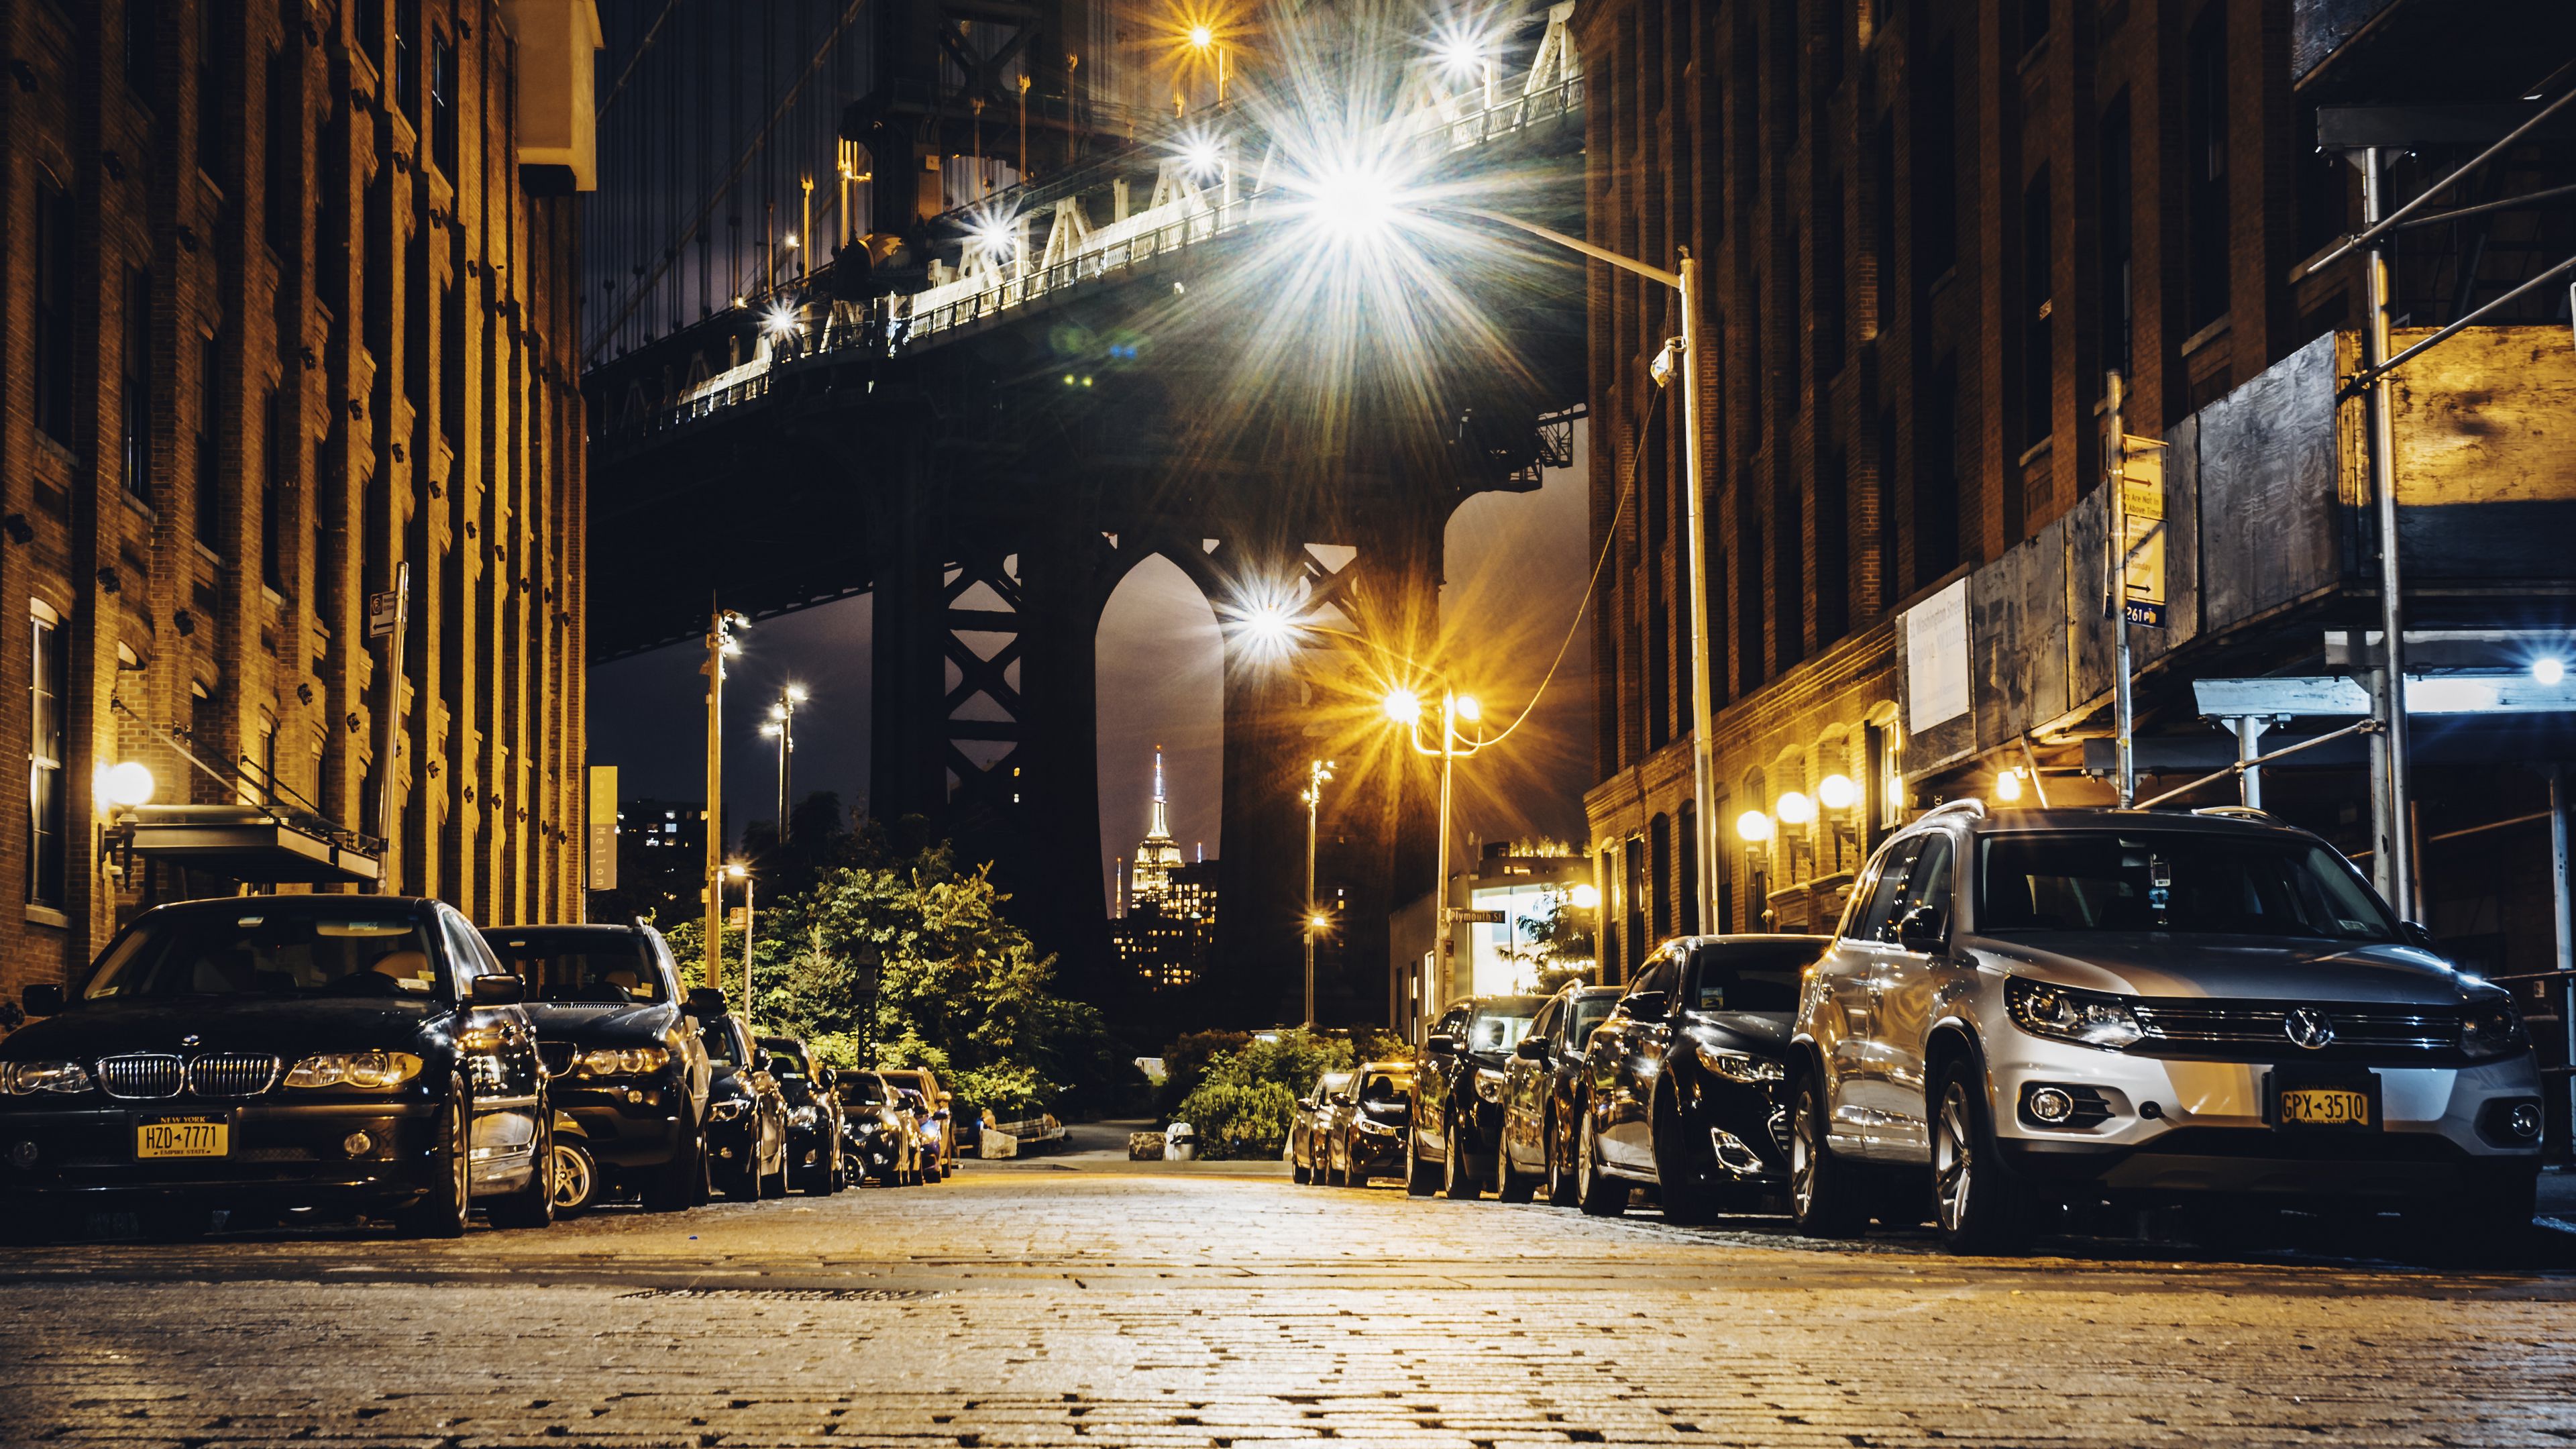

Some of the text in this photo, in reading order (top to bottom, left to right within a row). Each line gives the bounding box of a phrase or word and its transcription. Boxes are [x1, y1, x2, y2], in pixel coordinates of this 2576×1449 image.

[2132, 494, 2141, 502] Are
[2143, 496, 2152, 504] Not
[2129, 504, 2145, 515] Above
[2131, 559, 2151, 573] Sunday
[1947, 595, 1963, 619] Street
[596, 771, 606, 820] Smack
[596, 827, 606, 885] Mellon
[1450, 911, 1502, 923] Plymouth St
